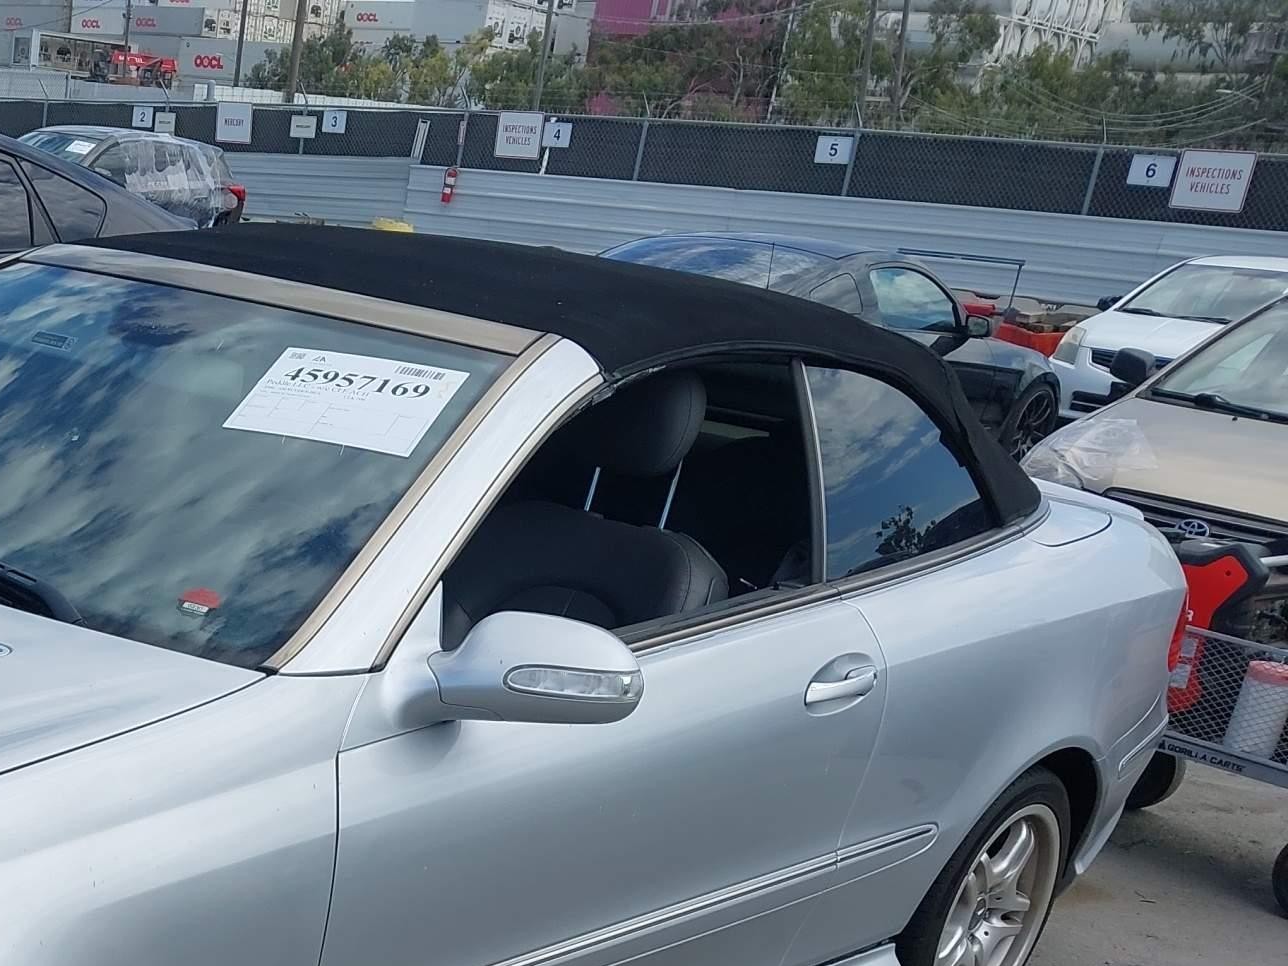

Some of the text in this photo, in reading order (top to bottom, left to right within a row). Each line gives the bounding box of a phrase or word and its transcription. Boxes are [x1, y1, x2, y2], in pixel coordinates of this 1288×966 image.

[81, 18, 101, 29] OOCL
[135, 18, 156, 28] OOCL
[194, 54, 224, 70] OOCL
[139, 111, 146, 123] 2
[331, 116, 338, 128] 3
[503, 125, 538, 135] INSPECTIONS
[553, 129, 562, 141] 4
[506, 136, 532, 146] VEHICLES
[828, 143, 839, 157] 5
[1145, 163, 1158, 178] 6
[1186, 167, 1243, 180] INSPECTIONS
[1190, 182, 1231, 195] VEHICLES
[284, 367, 431, 399] 45957169
[1209, 756, 1243, 773] CARTS
